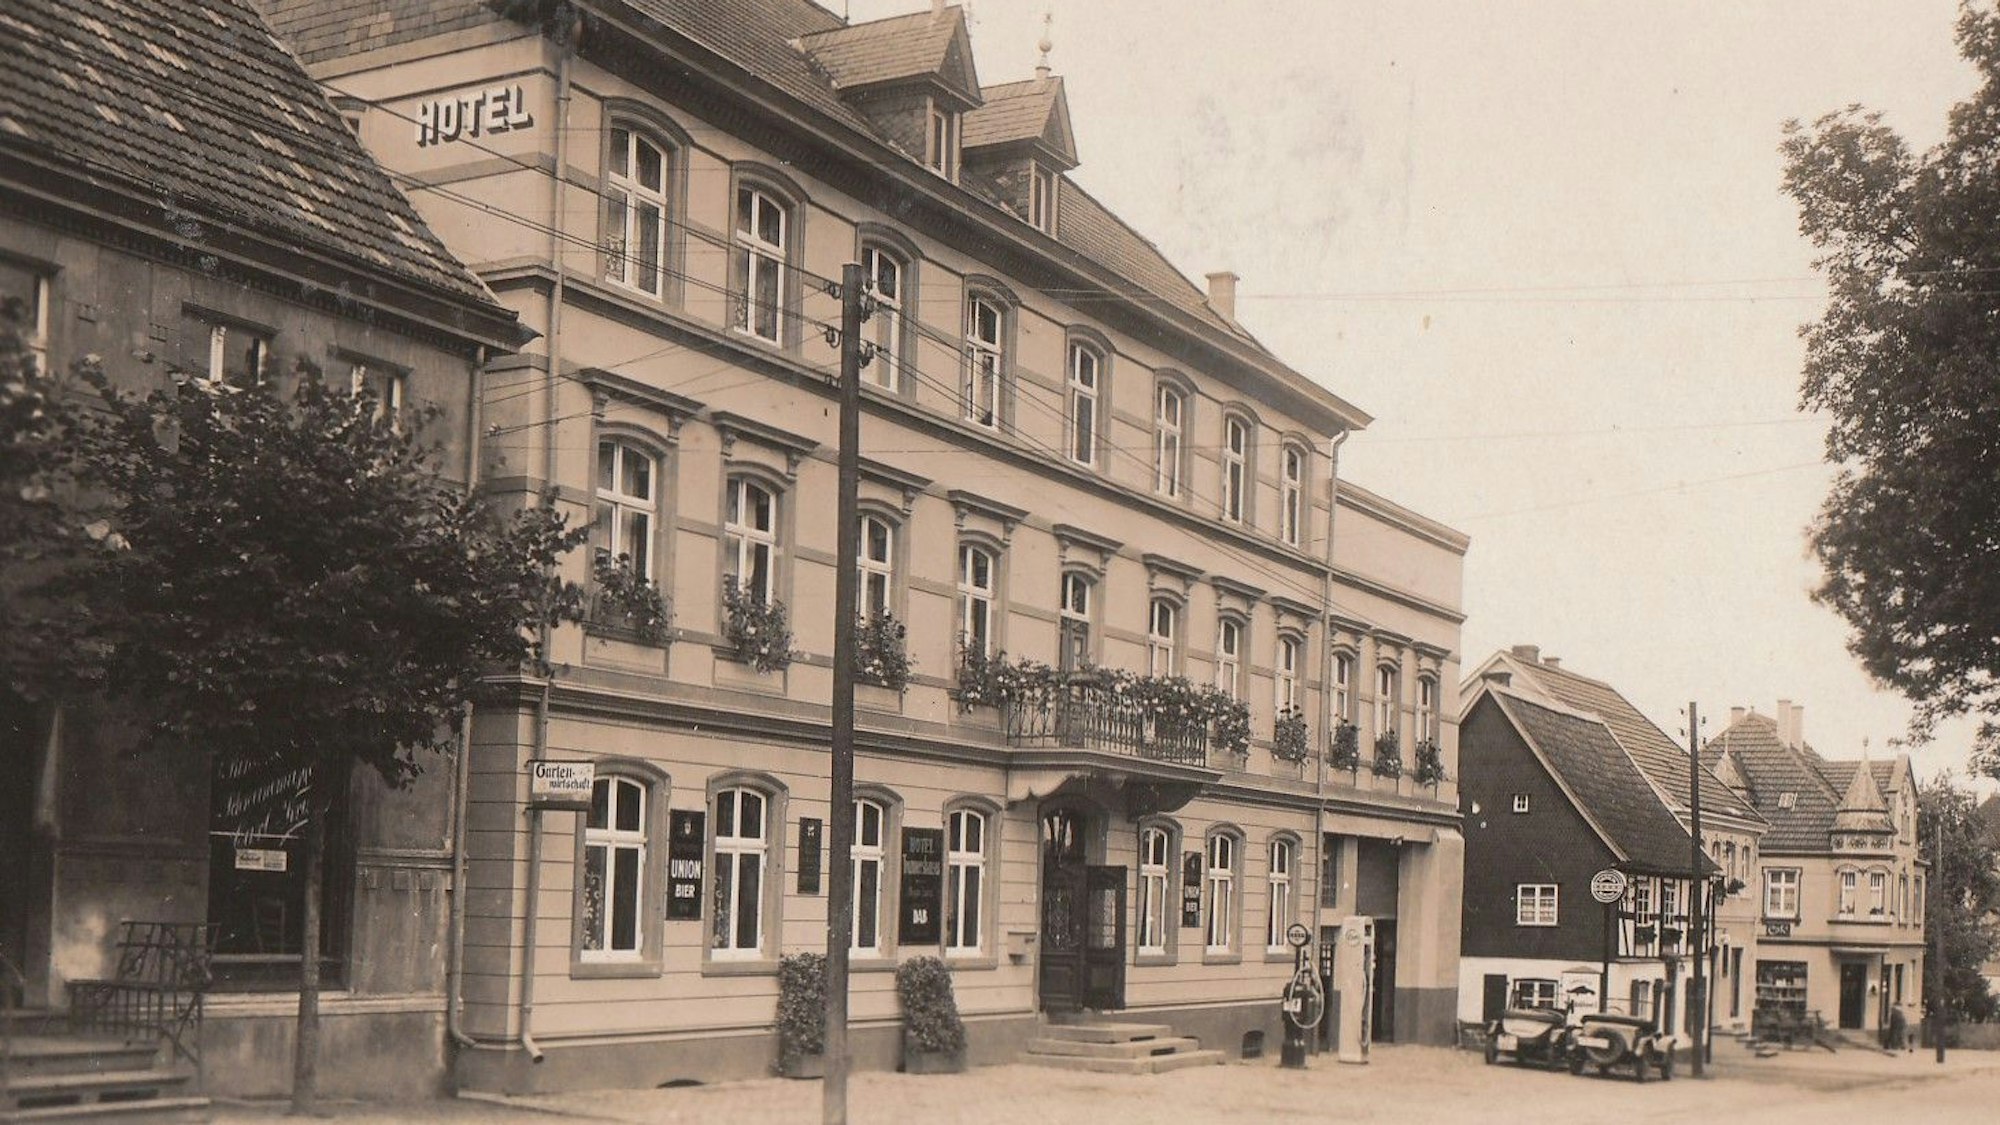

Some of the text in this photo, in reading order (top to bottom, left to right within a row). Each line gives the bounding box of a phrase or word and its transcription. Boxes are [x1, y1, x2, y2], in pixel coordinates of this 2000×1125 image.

[415, 84, 533, 147] HOTEL
[671, 859, 701, 879] UNION
[675, 884, 696, 899] BIER
[912, 909, 928, 925] DAB
